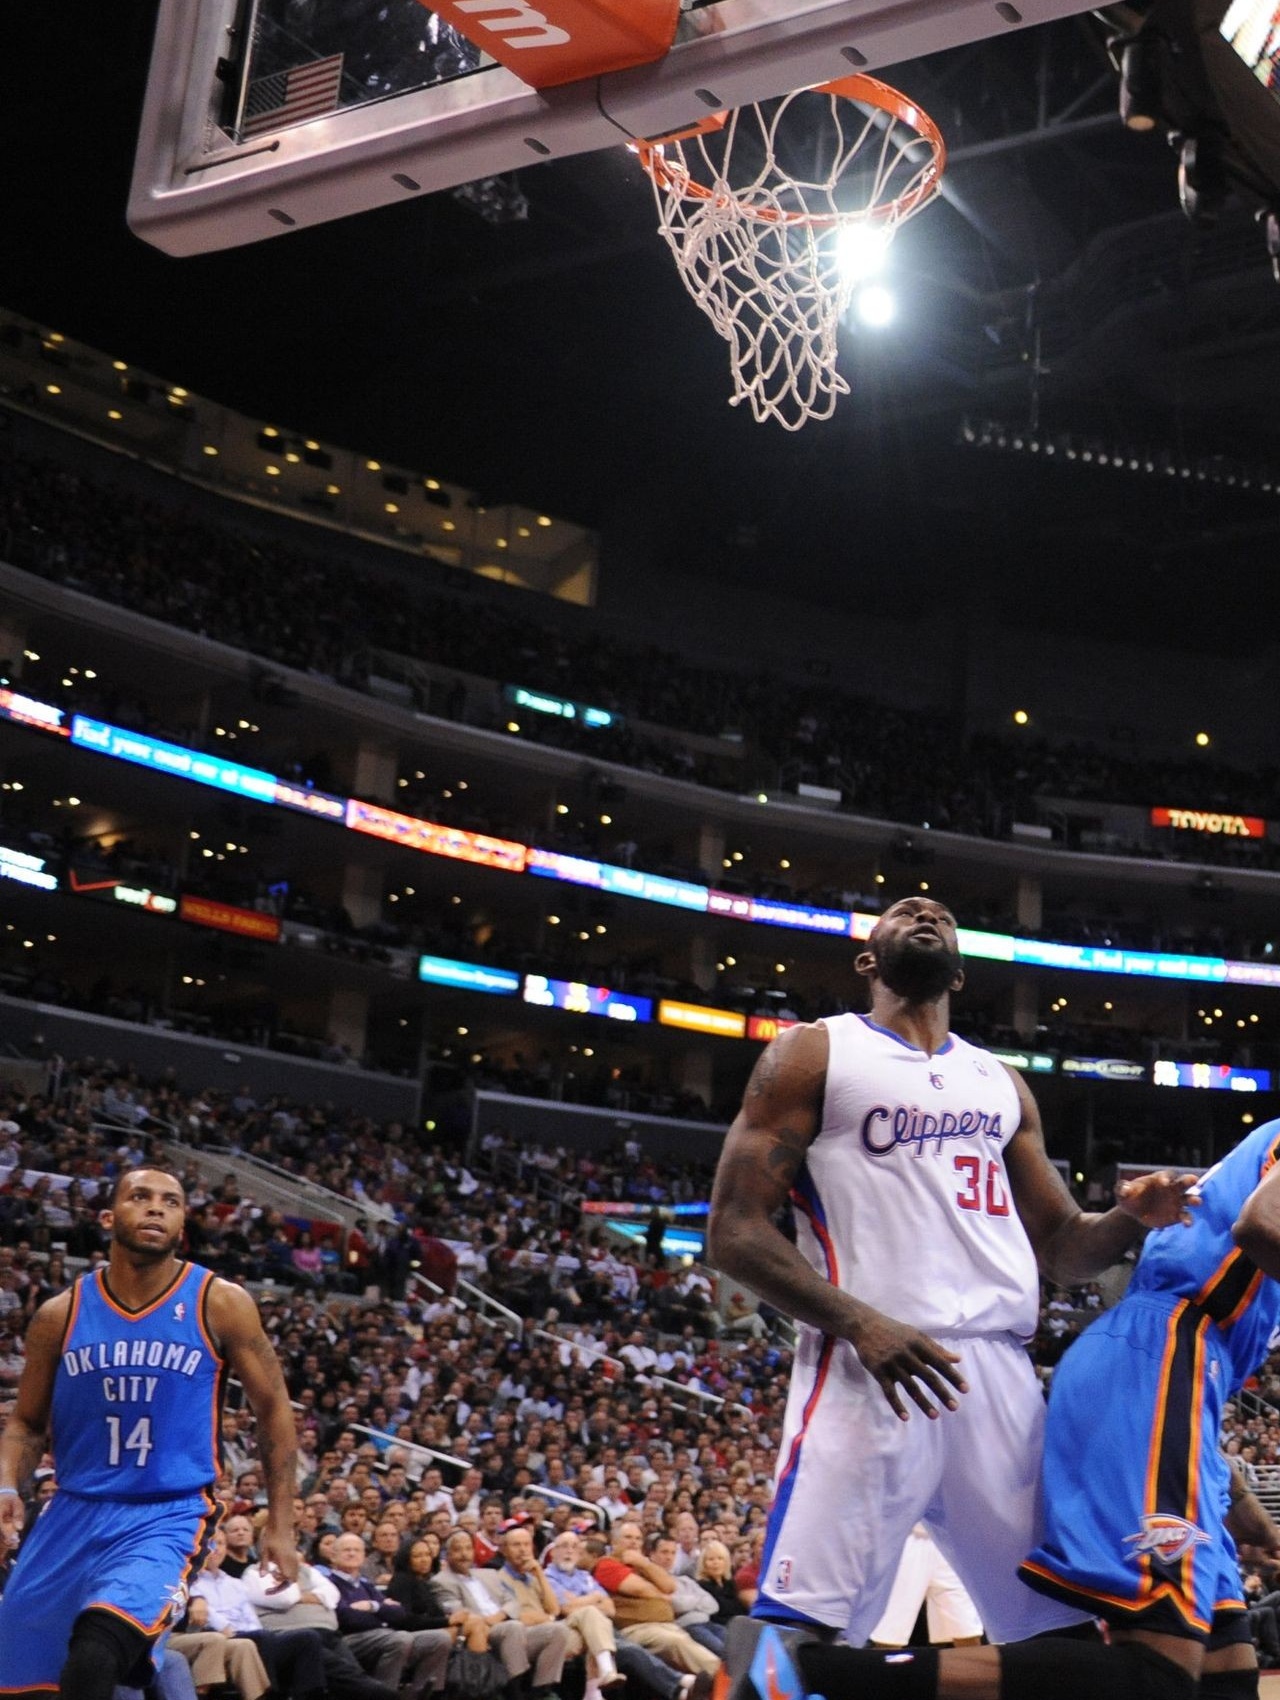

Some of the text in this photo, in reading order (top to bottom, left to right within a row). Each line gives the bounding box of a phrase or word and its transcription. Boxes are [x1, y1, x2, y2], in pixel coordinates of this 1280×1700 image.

[1168, 809, 1250, 836] TOYOTA
[63, 1339, 203, 1378] OKLAHOMA
[101, 1375, 159, 1402] CITY
[105, 1415, 152, 1468] 14
